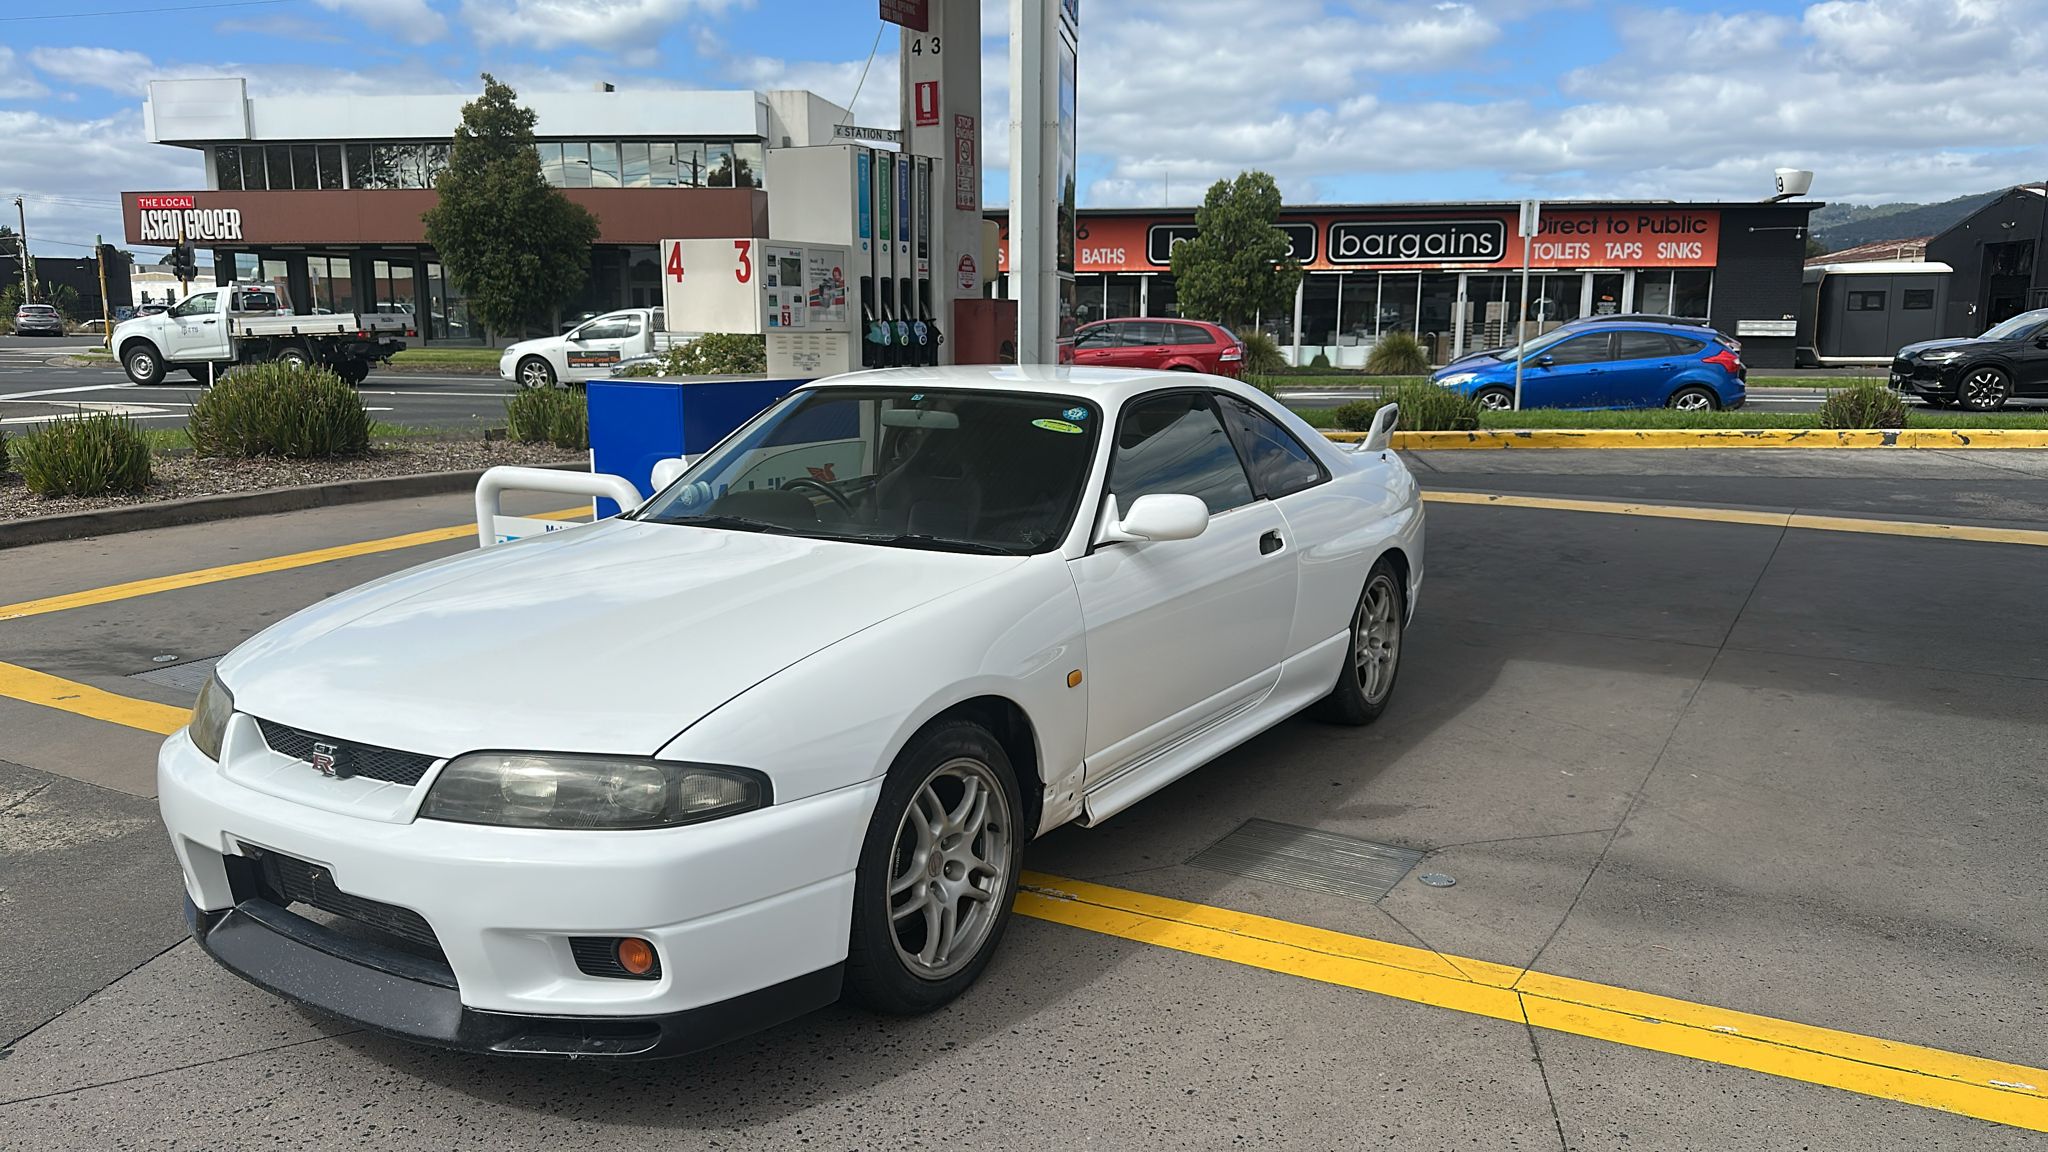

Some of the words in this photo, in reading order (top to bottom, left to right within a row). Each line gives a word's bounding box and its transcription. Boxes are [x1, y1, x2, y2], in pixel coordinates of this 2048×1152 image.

[912, 38, 922, 56] 4
[931, 37, 941, 54] 3
[844, 127, 882, 140] STATION
[887, 131, 897, 141] ST
[140, 198, 158, 207] THE
[160, 198, 191, 207] LOCAL
[184, 209, 242, 240] GROCER
[1538, 216, 1599, 235] Direct
[1606, 216, 1630, 235] to
[1637, 215, 1708, 235] Public
[1339, 228, 1493, 260] bargains
[1533, 242, 1591, 260] TOILETS
[1605, 242, 1643, 260] TAPS
[1657, 242, 1702, 260] SINKS
[668, 241, 684, 283] 4
[735, 240, 751, 284] 3
[1082, 247, 1126, 264] BATHS
[783, 312, 790, 325] 3
[313, 742, 338, 755] GT
[312, 751, 336, 776] R
